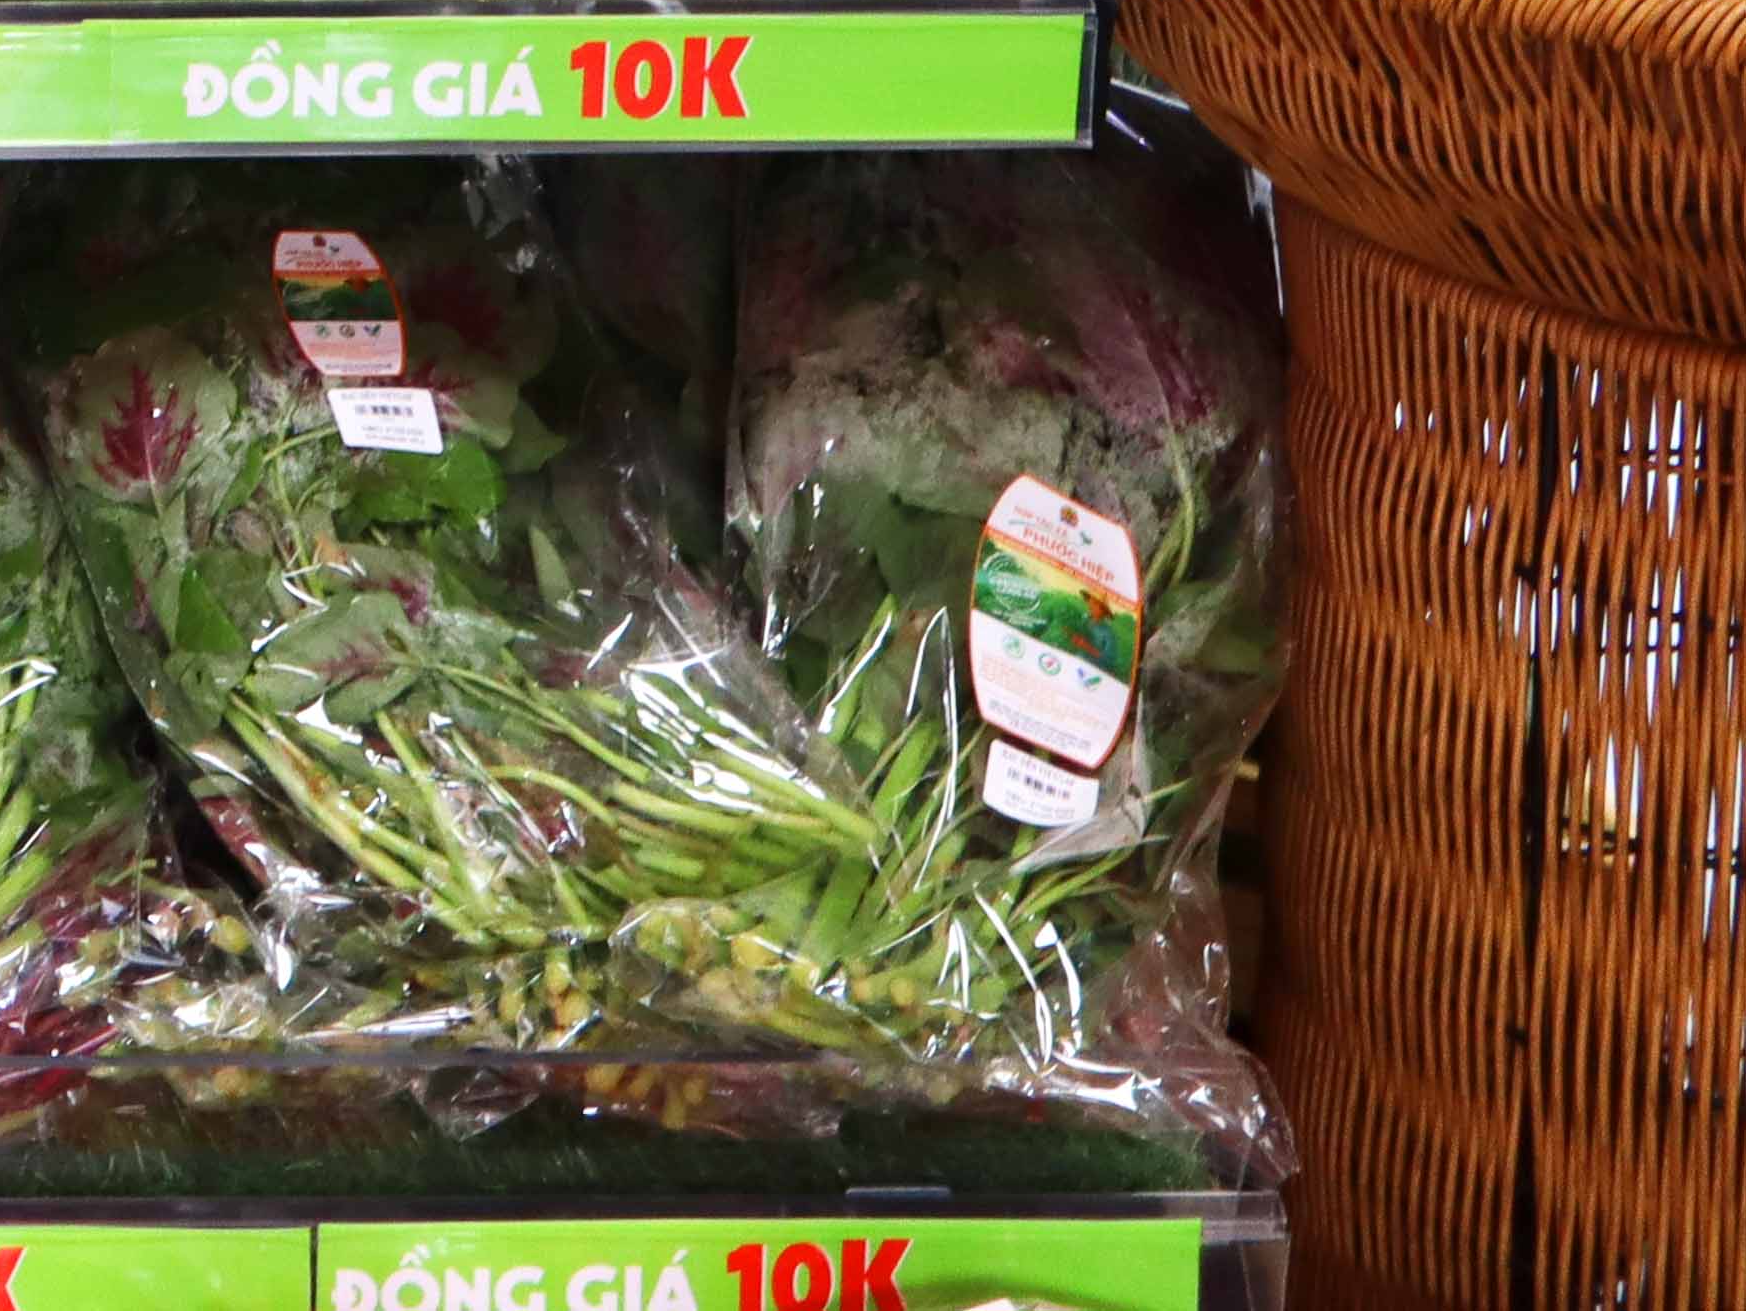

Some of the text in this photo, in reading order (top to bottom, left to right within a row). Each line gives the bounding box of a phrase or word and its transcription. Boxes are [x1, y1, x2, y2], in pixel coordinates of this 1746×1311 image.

[181, 35, 752, 121] ĐỒNG GIÁ 10K
[331, 1238, 914, 1311] ĐỒNG GIÁ 10K
